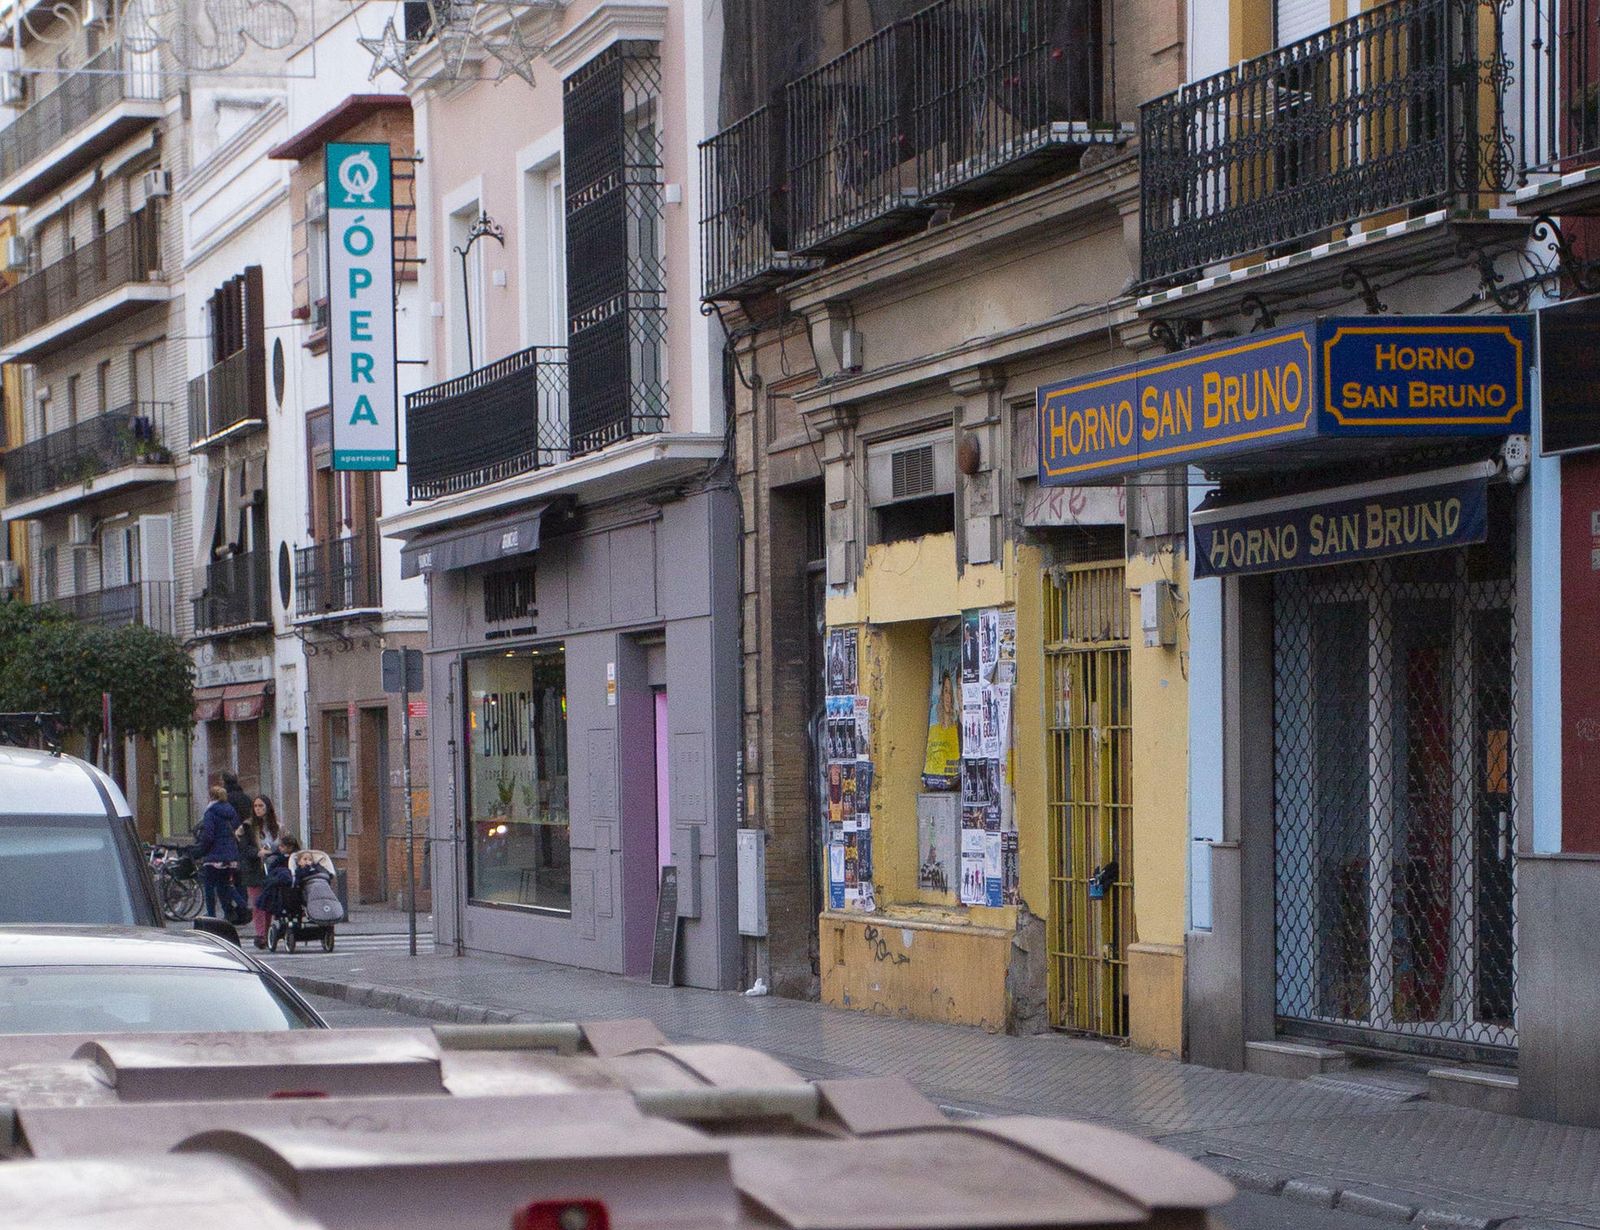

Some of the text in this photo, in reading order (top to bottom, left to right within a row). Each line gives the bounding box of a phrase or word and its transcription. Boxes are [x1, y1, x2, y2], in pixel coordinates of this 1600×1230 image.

[343, 215, 379, 425] ÓPERA
[1375, 343, 1475, 371] HORNO
[1050, 361, 1303, 459] HORNO SAN BRUNO
[1341, 380, 1507, 408] SAN BRUNO
[340, 454, 390, 464] apartments
[1209, 497, 1462, 569] HORNO SAN BRUNO
